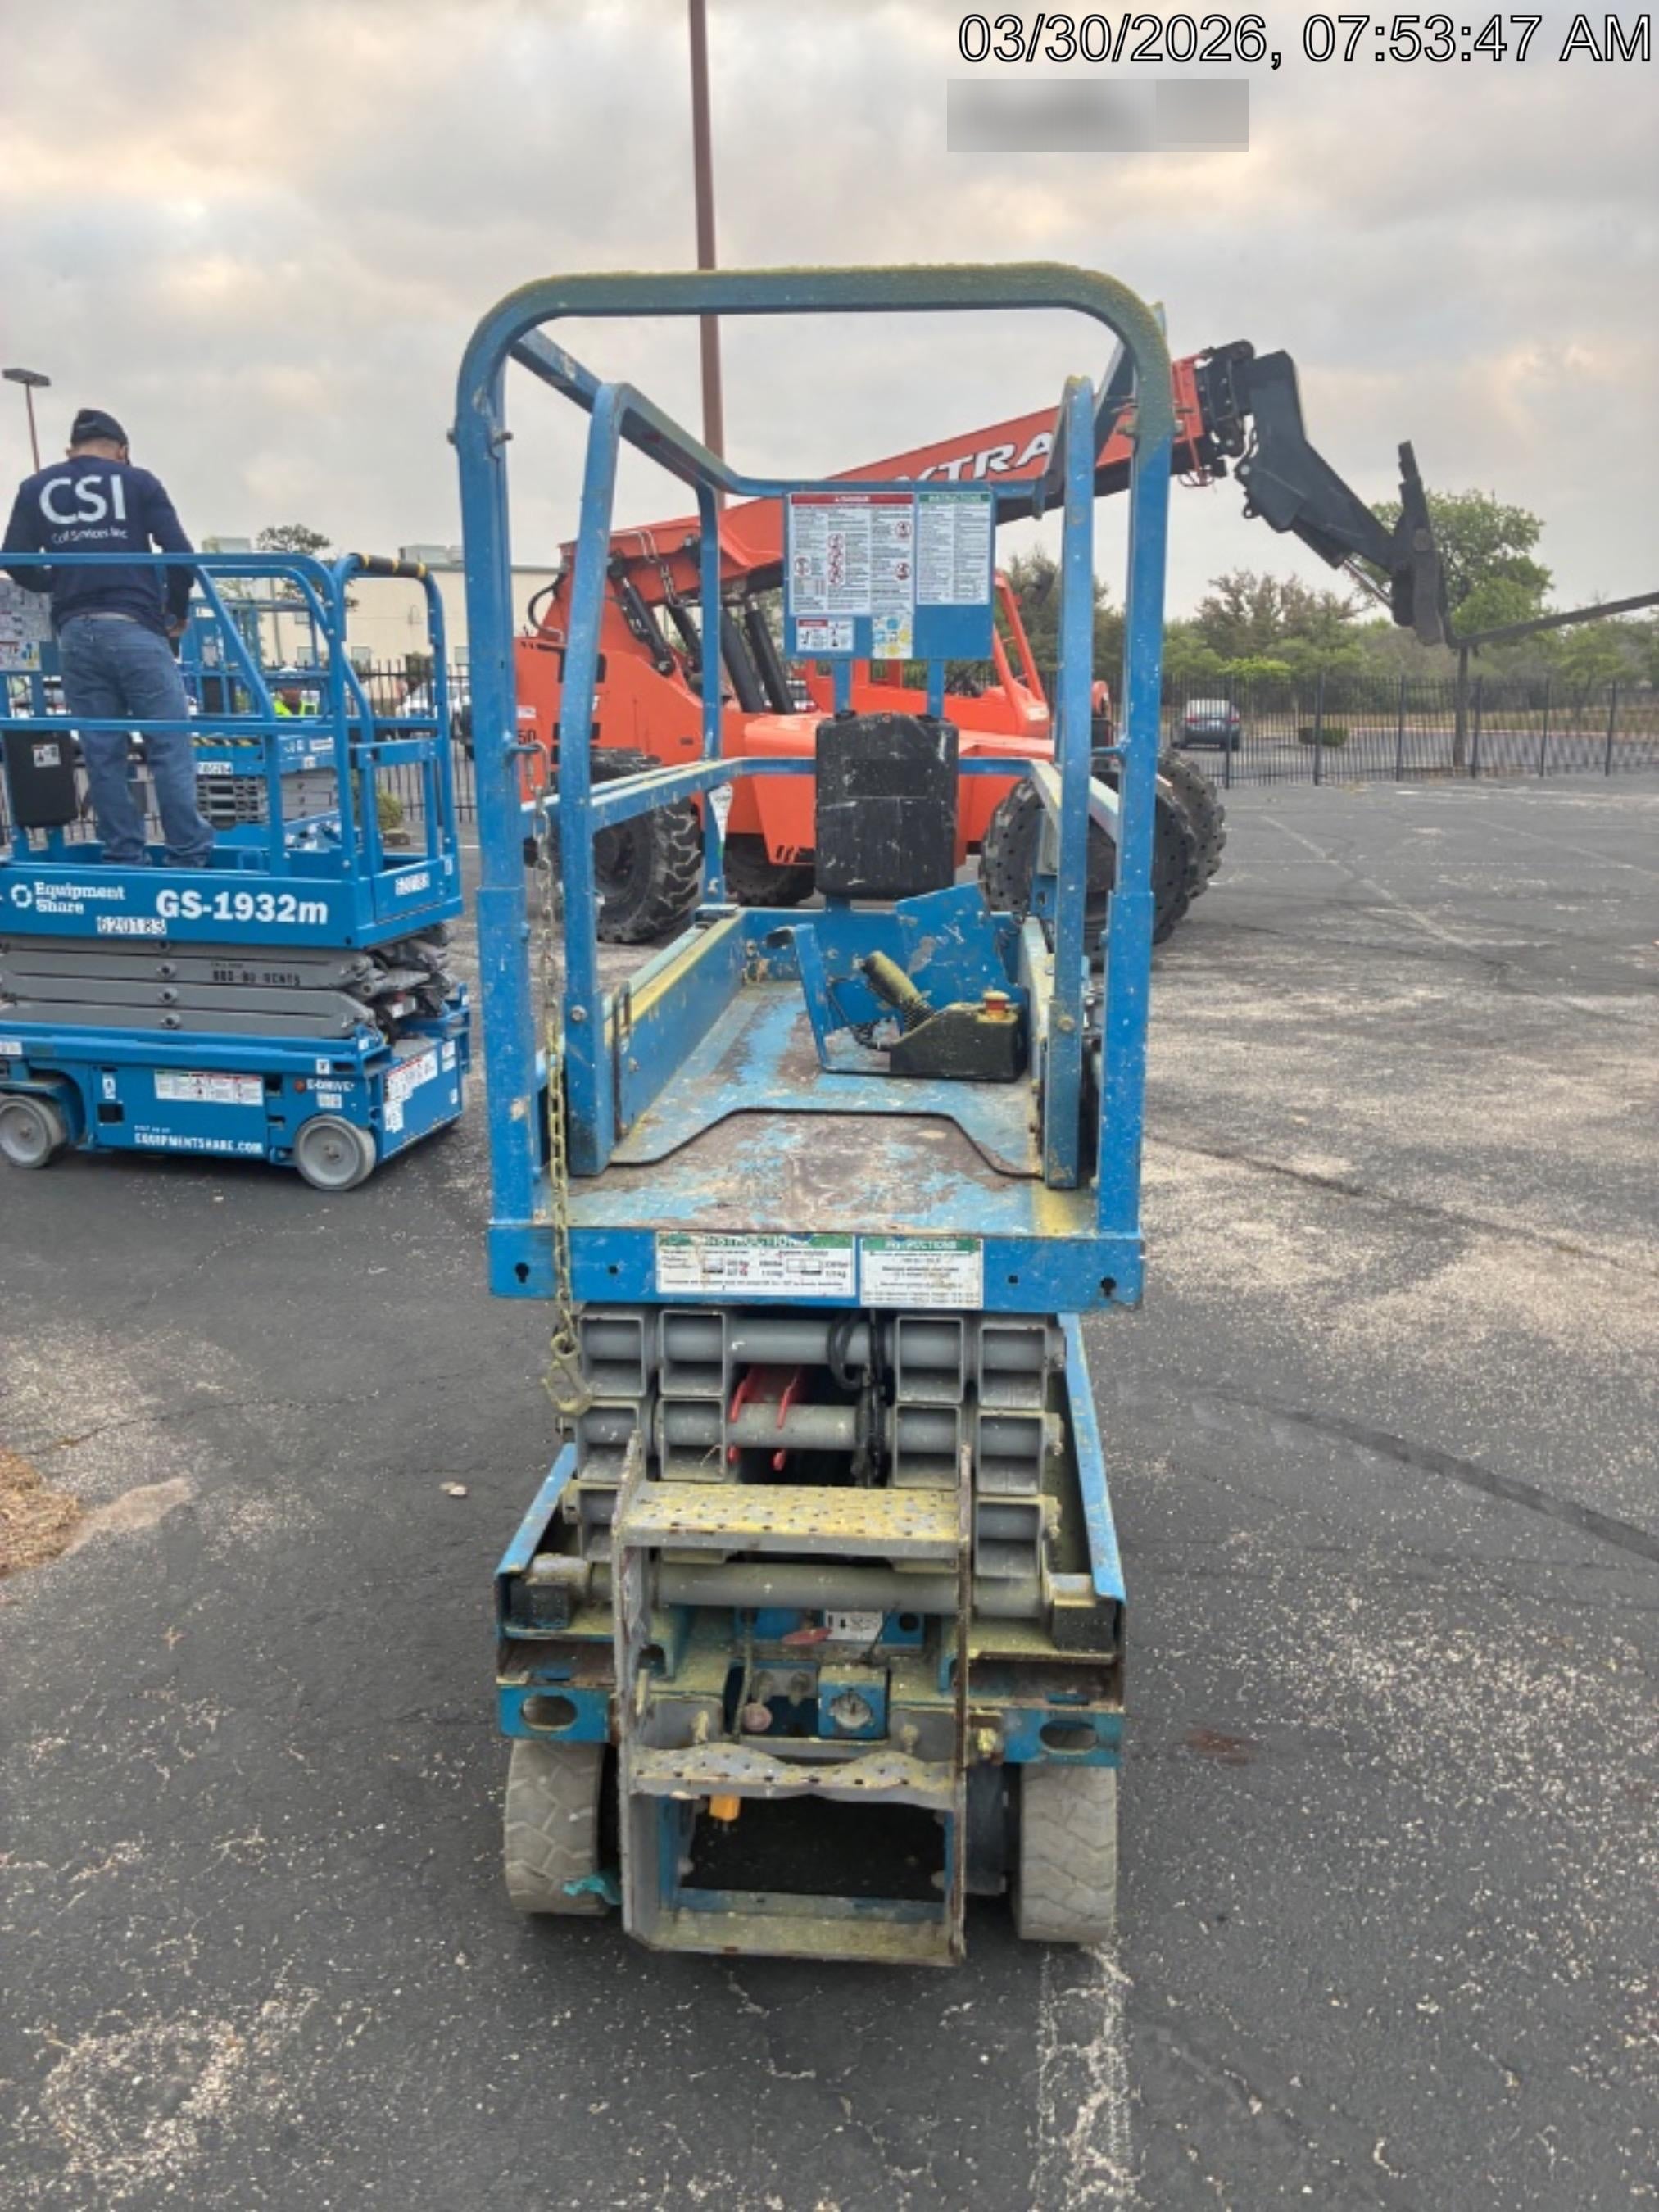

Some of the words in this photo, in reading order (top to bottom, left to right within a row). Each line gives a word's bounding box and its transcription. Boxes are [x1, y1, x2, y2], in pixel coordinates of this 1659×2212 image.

[39, 474, 126, 524] CSI
[34, 882, 125, 900] Equipment
[36, 899, 84, 914] Share
[156, 888, 329, 925] GS-1932m
